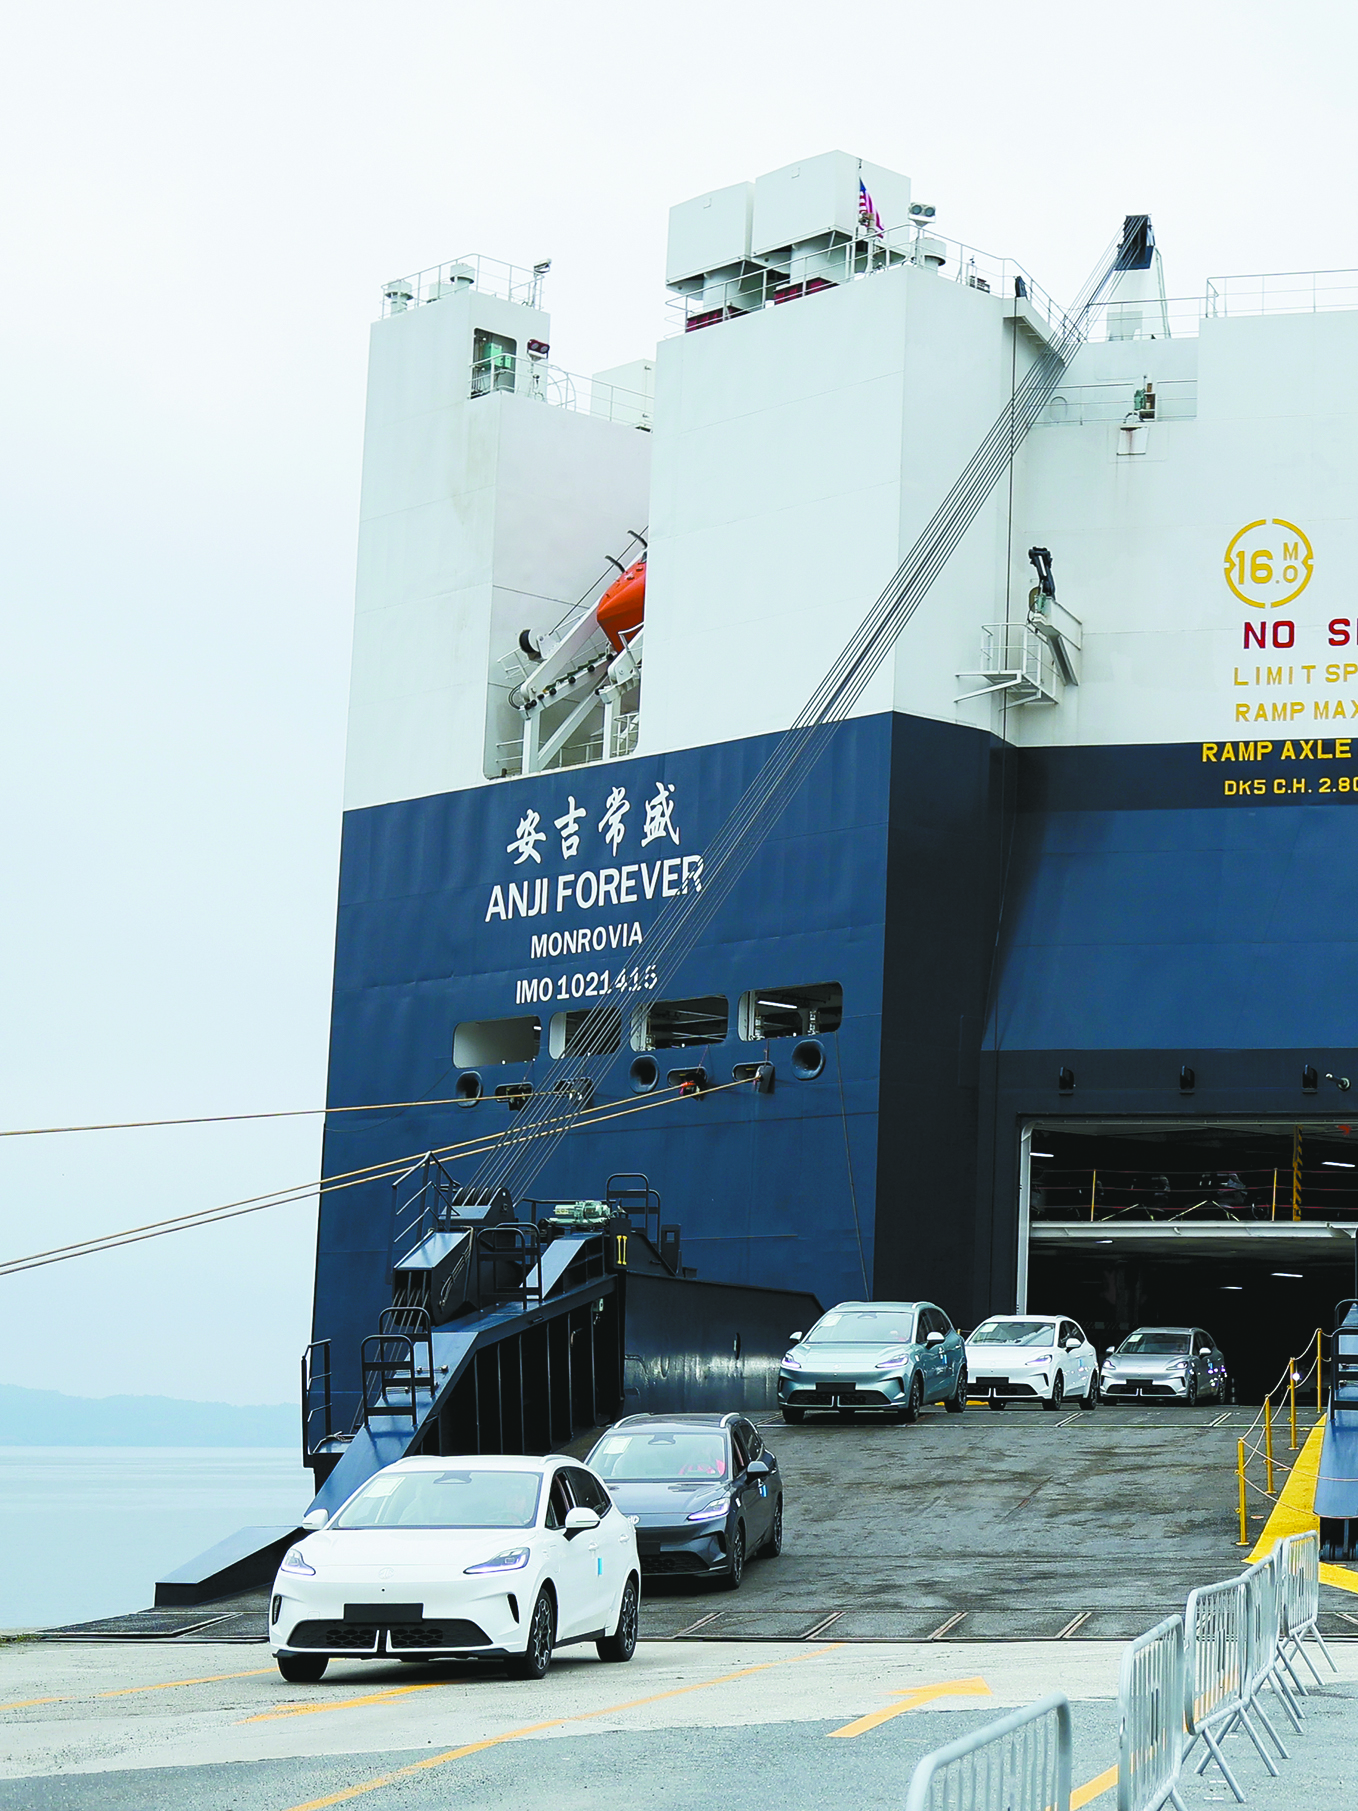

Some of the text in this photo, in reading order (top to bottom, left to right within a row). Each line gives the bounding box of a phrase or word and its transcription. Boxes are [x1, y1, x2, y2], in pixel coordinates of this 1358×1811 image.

[1244, 620, 1295, 649] NO
[1234, 664, 1317, 686] LIMIT
[1235, 701, 1305, 722] RAMP
[1202, 741, 1273, 763] RAMP
[1281, 738, 1352, 760] AXLE
[1224, 778, 1266, 796] DK5
[1273, 777, 1312, 795] C.H.
[506, 781, 680, 865] 安吉常盛
[485, 854, 704, 923] ANJI FOREVER
[531, 921, 643, 959] MONROVIA
[515, 974, 552, 1005] IMO
